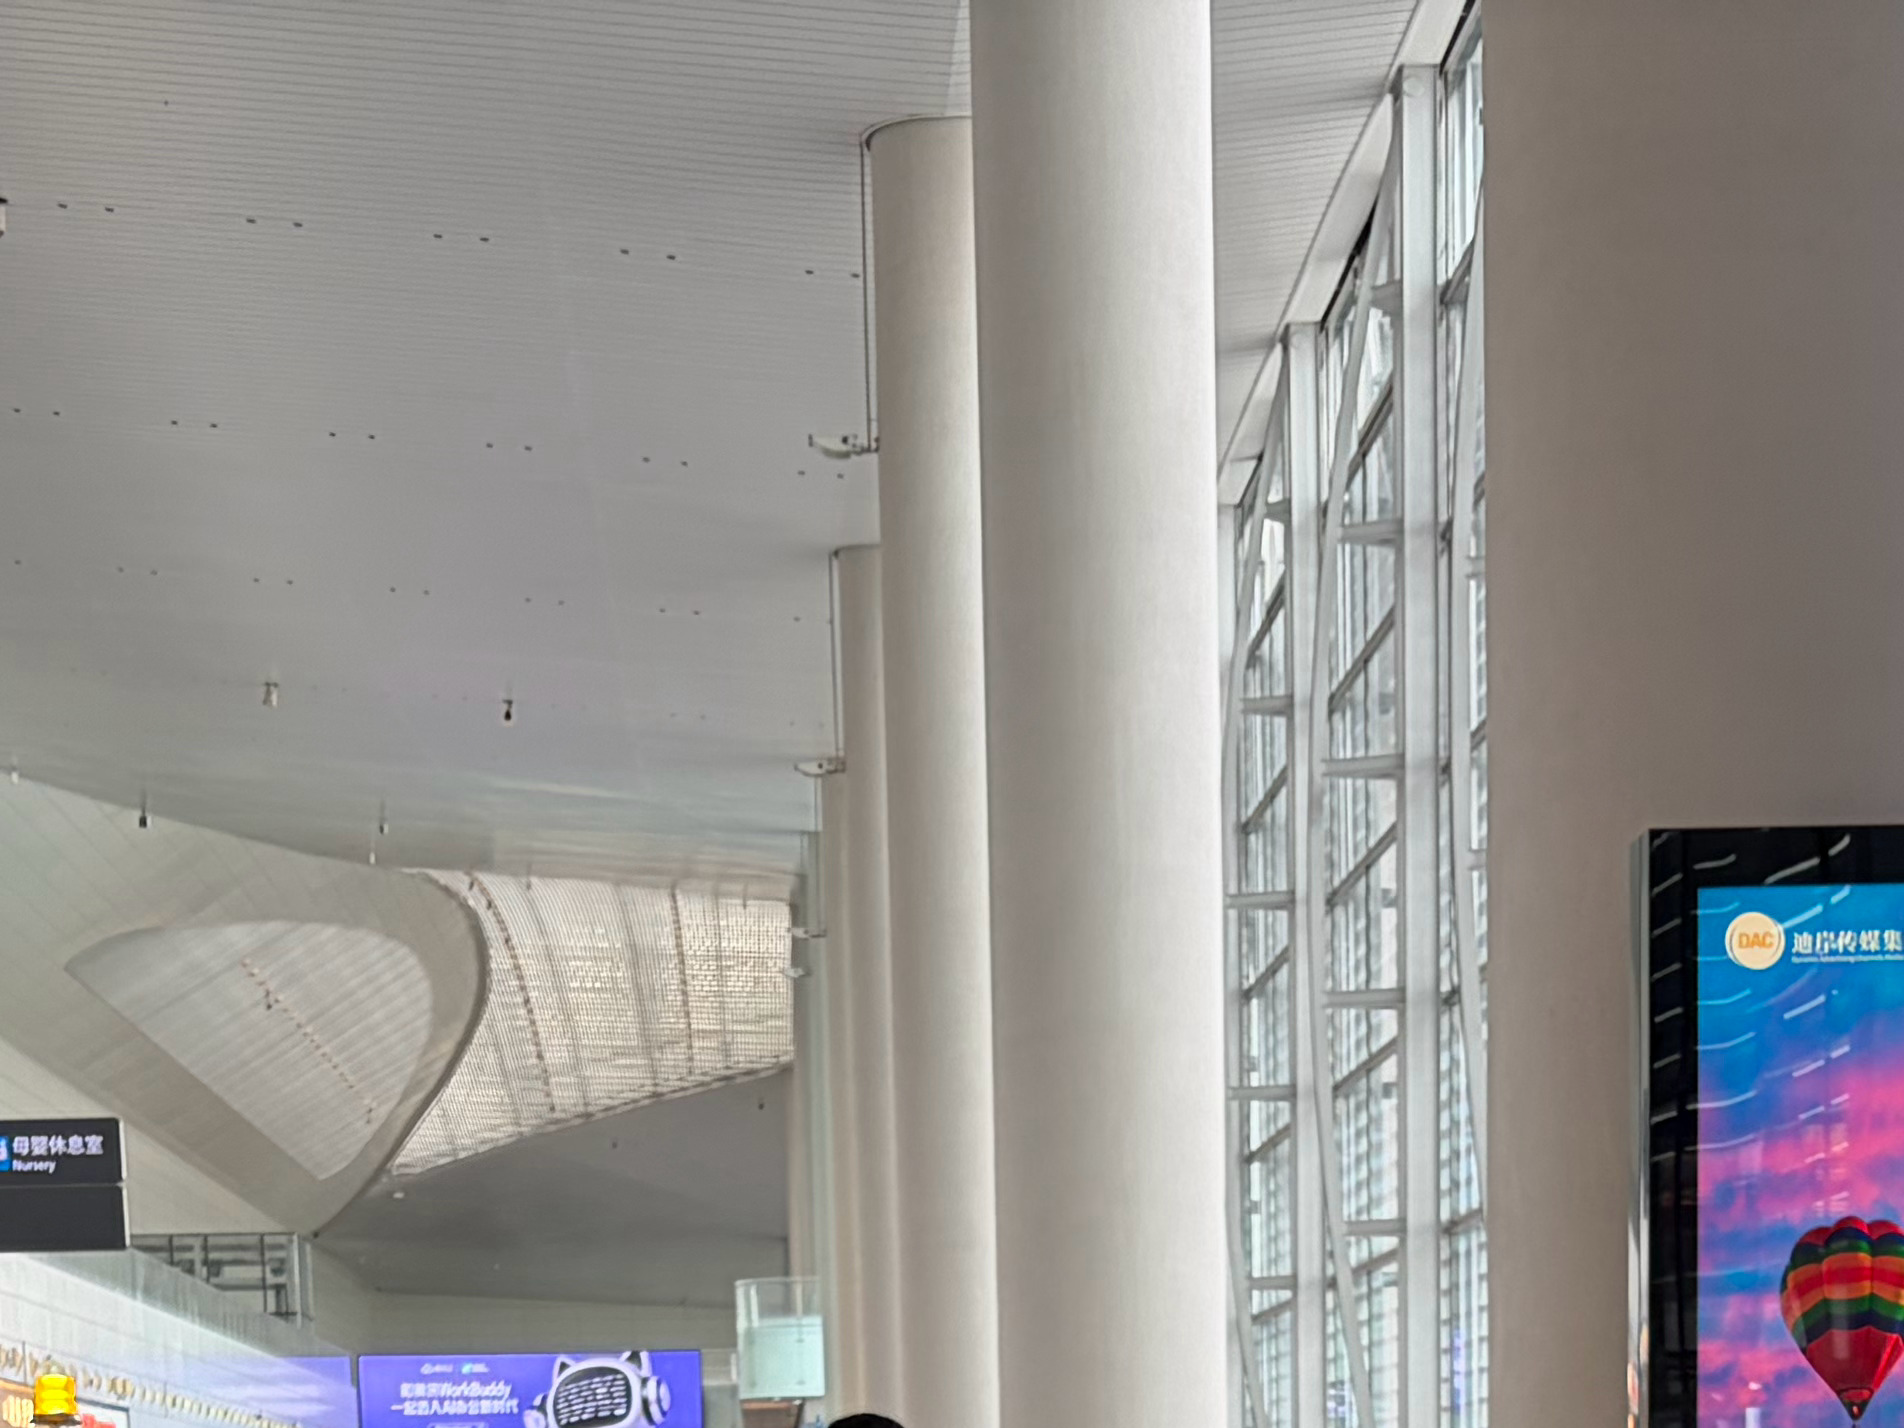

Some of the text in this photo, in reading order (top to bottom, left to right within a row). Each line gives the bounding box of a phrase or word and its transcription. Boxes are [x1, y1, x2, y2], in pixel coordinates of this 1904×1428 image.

[1738, 932, 1774, 949] DAC
[12, 1134, 104, 1158] 母婴休息室
[12, 1157, 56, 1174] Nursery
